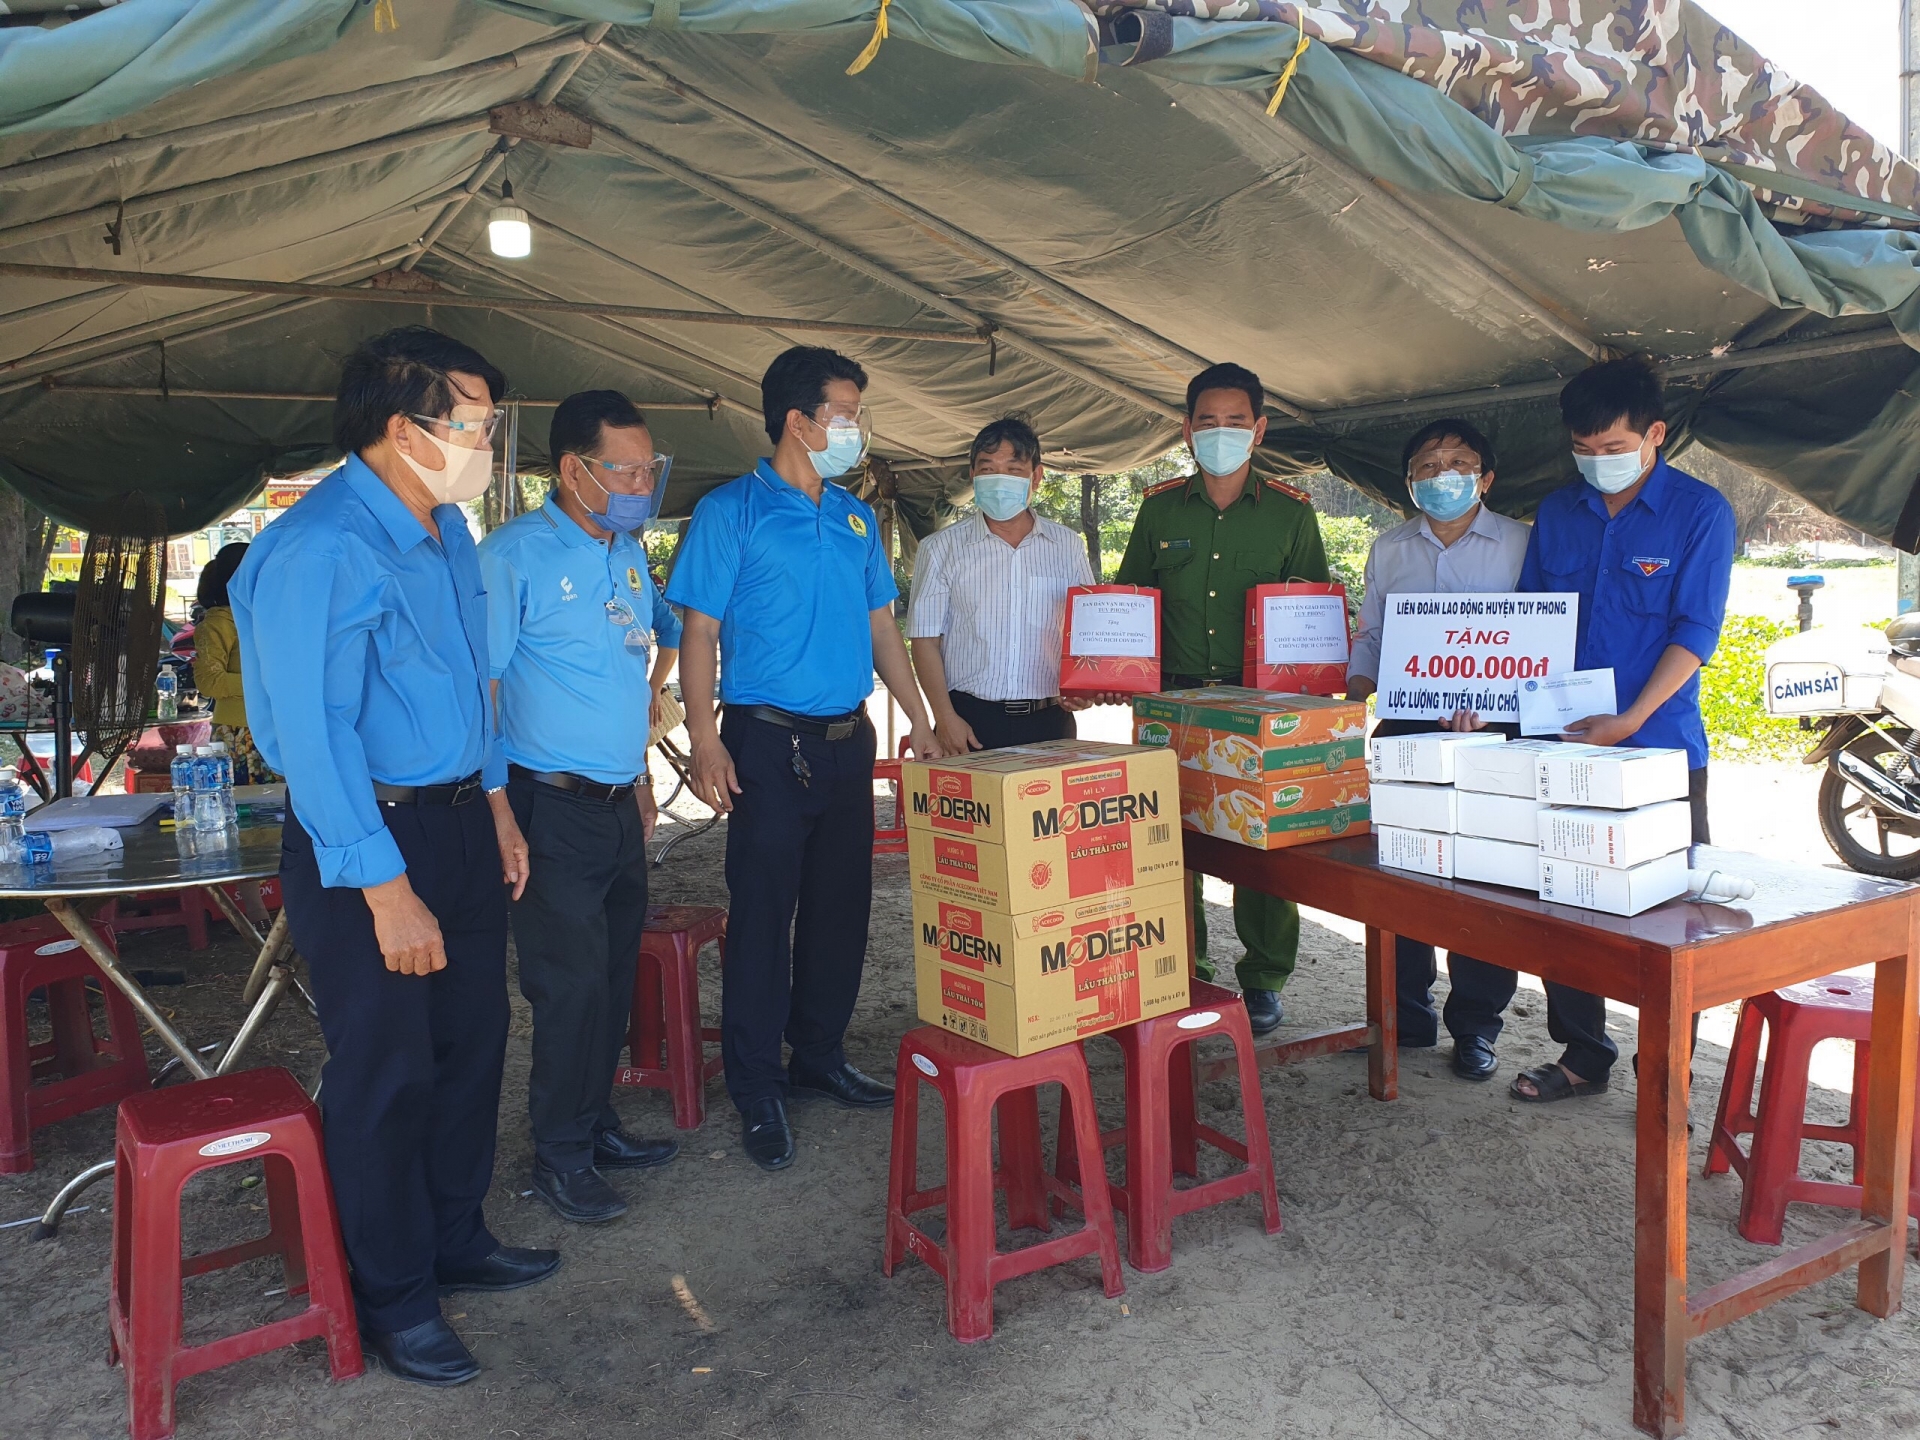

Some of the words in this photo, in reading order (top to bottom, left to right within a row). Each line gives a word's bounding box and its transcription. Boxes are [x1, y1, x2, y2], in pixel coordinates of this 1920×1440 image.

[562, 593, 578, 601] egan
[1397, 599, 1415, 615] LIÊN
[1417, 599, 1440, 615] ĐOÀN
[1442, 601, 1458, 615] LAO
[1460, 599, 1483, 618] ĐỘNG
[1486, 599, 1514, 618] HUYỆN
[1518, 601, 1534, 615] TUY
[1536, 601, 1567, 615] PHONG
[1444, 627, 1510, 648] TẶNG
[1404, 655, 1549, 679] 4.000.000đ
[1774, 677, 1813, 700] CẢNH
[1814, 671, 1839, 694] SÁT
[1388, 688, 1406, 713] LỰC
[1408, 688, 1439, 714] LƯỢNG
[1442, 688, 1473, 710] TUYẾN
[1476, 688, 1494, 711] ĐẦU
[1498, 690, 1519, 712] CHỐ
[1232, 715, 1254, 725] 1109564
[913, 792, 991, 828] MODERN
[1033, 790, 1159, 841] MODERN
[1070, 845, 1089, 860] LẨU
[1111, 841, 1128, 852] TÔM
[923, 923, 1002, 968] MODERN
[1041, 917, 1166, 976] MODERN
[1078, 978, 1095, 992] LẨU
